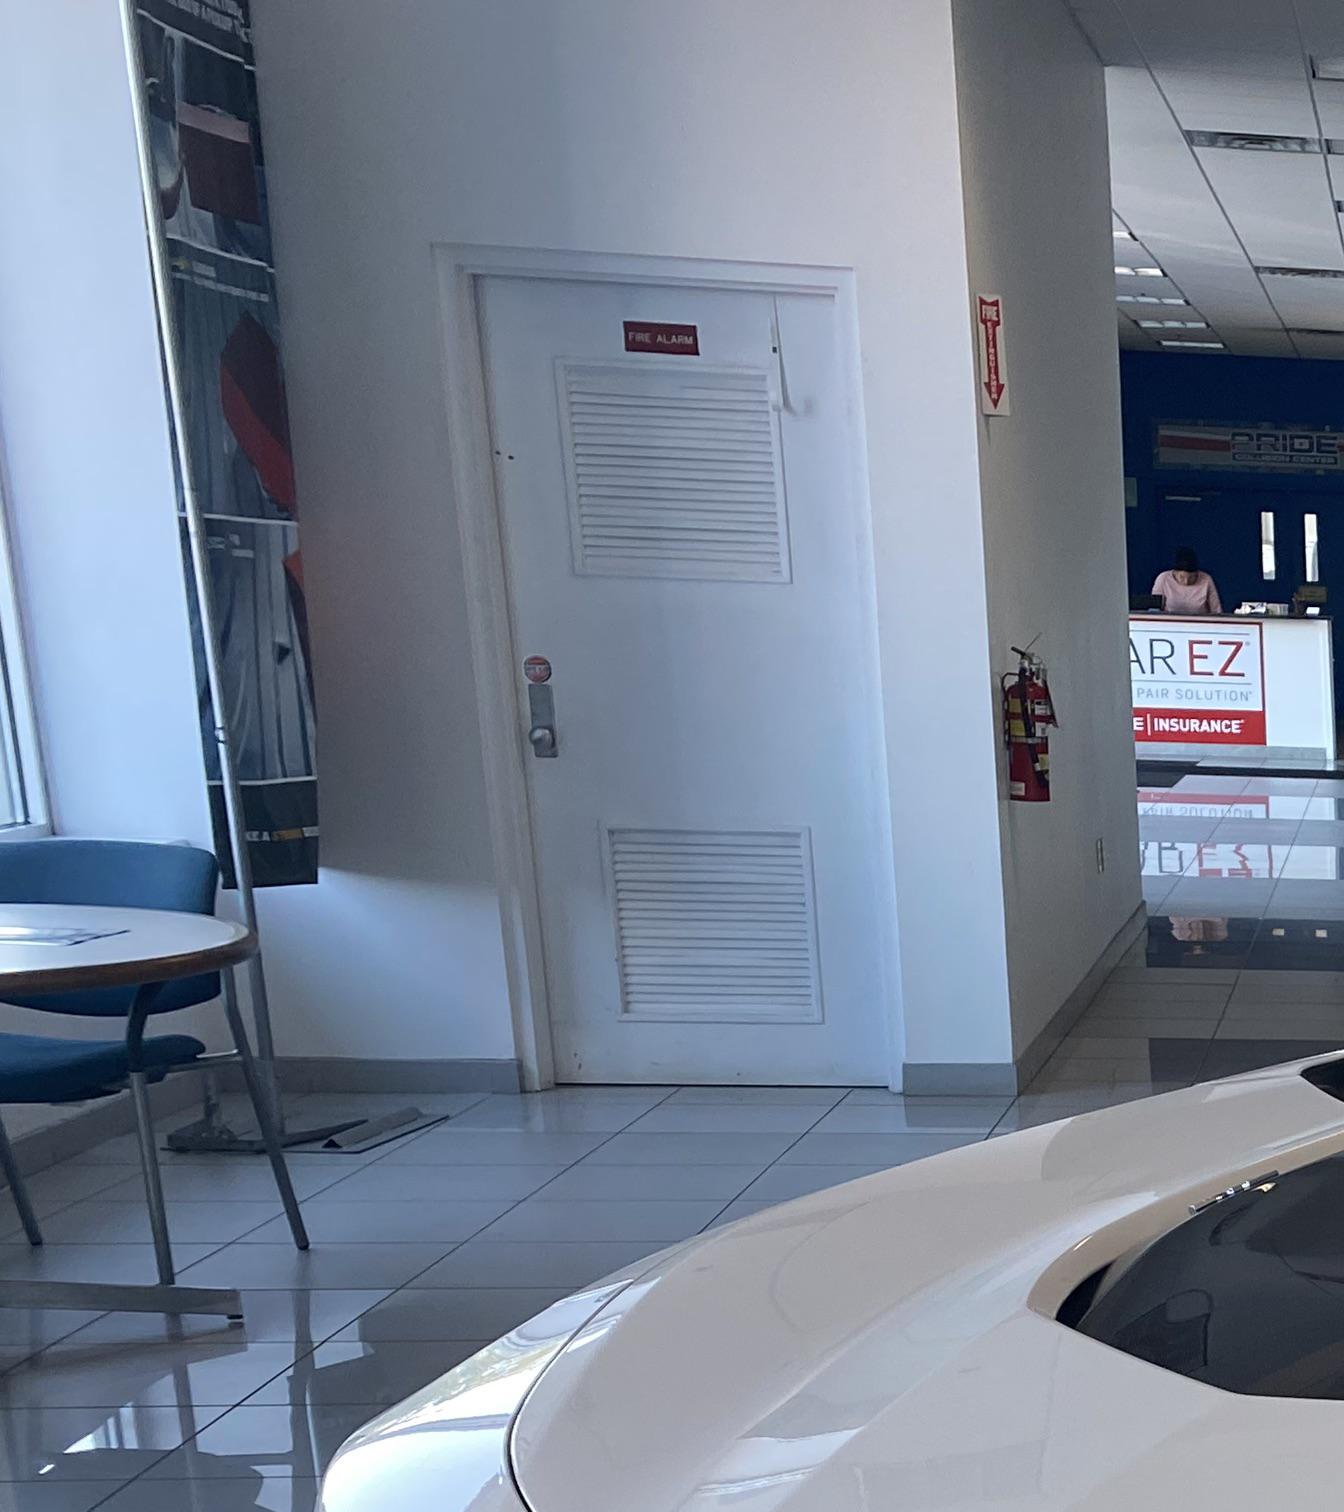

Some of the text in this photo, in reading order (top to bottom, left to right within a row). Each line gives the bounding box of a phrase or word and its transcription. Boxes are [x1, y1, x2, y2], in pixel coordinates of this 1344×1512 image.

[628, 331, 693, 344] FIRE ALARM
[1231, 431, 1338, 454] PRIDE
[1175, 688, 1250, 701] SOLUTION
[1153, 717, 1242, 733] INSURANCE
